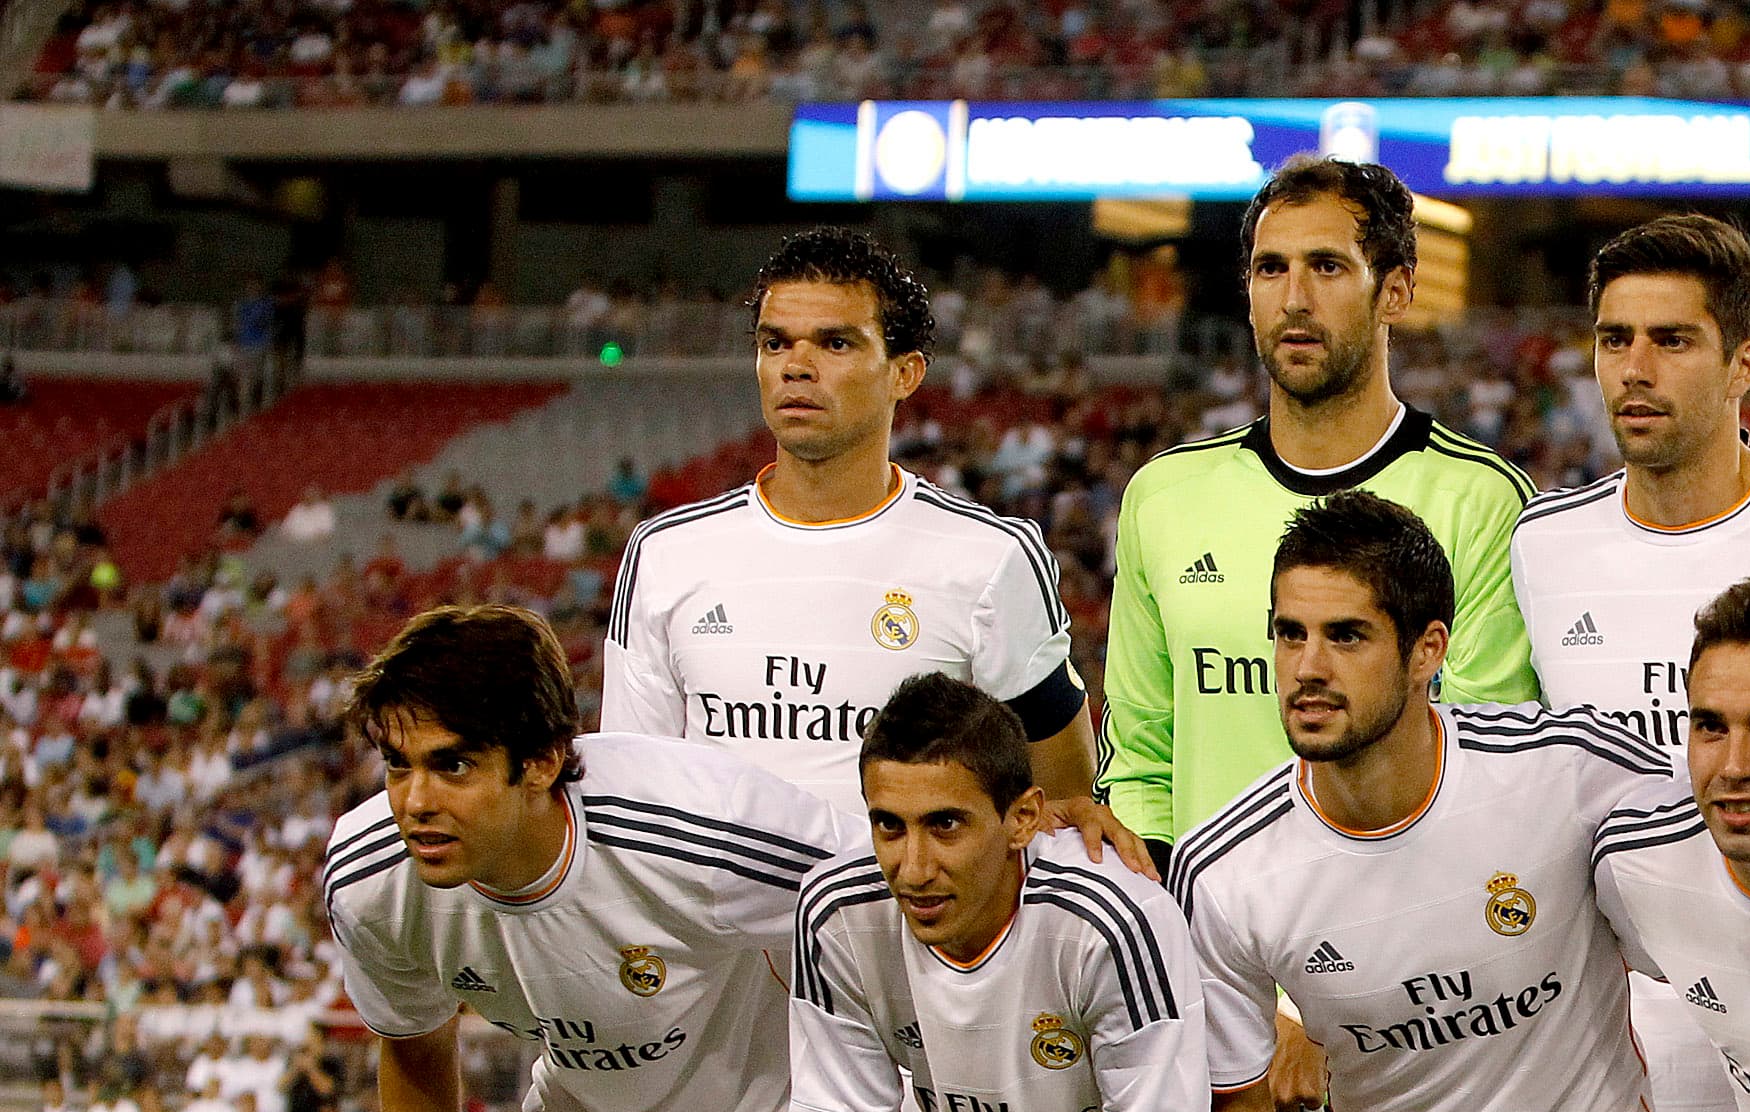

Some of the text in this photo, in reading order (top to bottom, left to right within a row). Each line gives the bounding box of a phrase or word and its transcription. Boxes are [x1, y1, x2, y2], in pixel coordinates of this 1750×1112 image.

[1179, 572, 1225, 584] adidas
[691, 622, 733, 635] adidas
[1561, 633, 1604, 647] adidas
[765, 655, 826, 695] Fly
[1304, 958, 1355, 974] adidas
[1401, 970, 1473, 1005] Fly
[1339, 970, 1563, 1053] Emirates
[1685, 991, 1728, 1014] adidas
